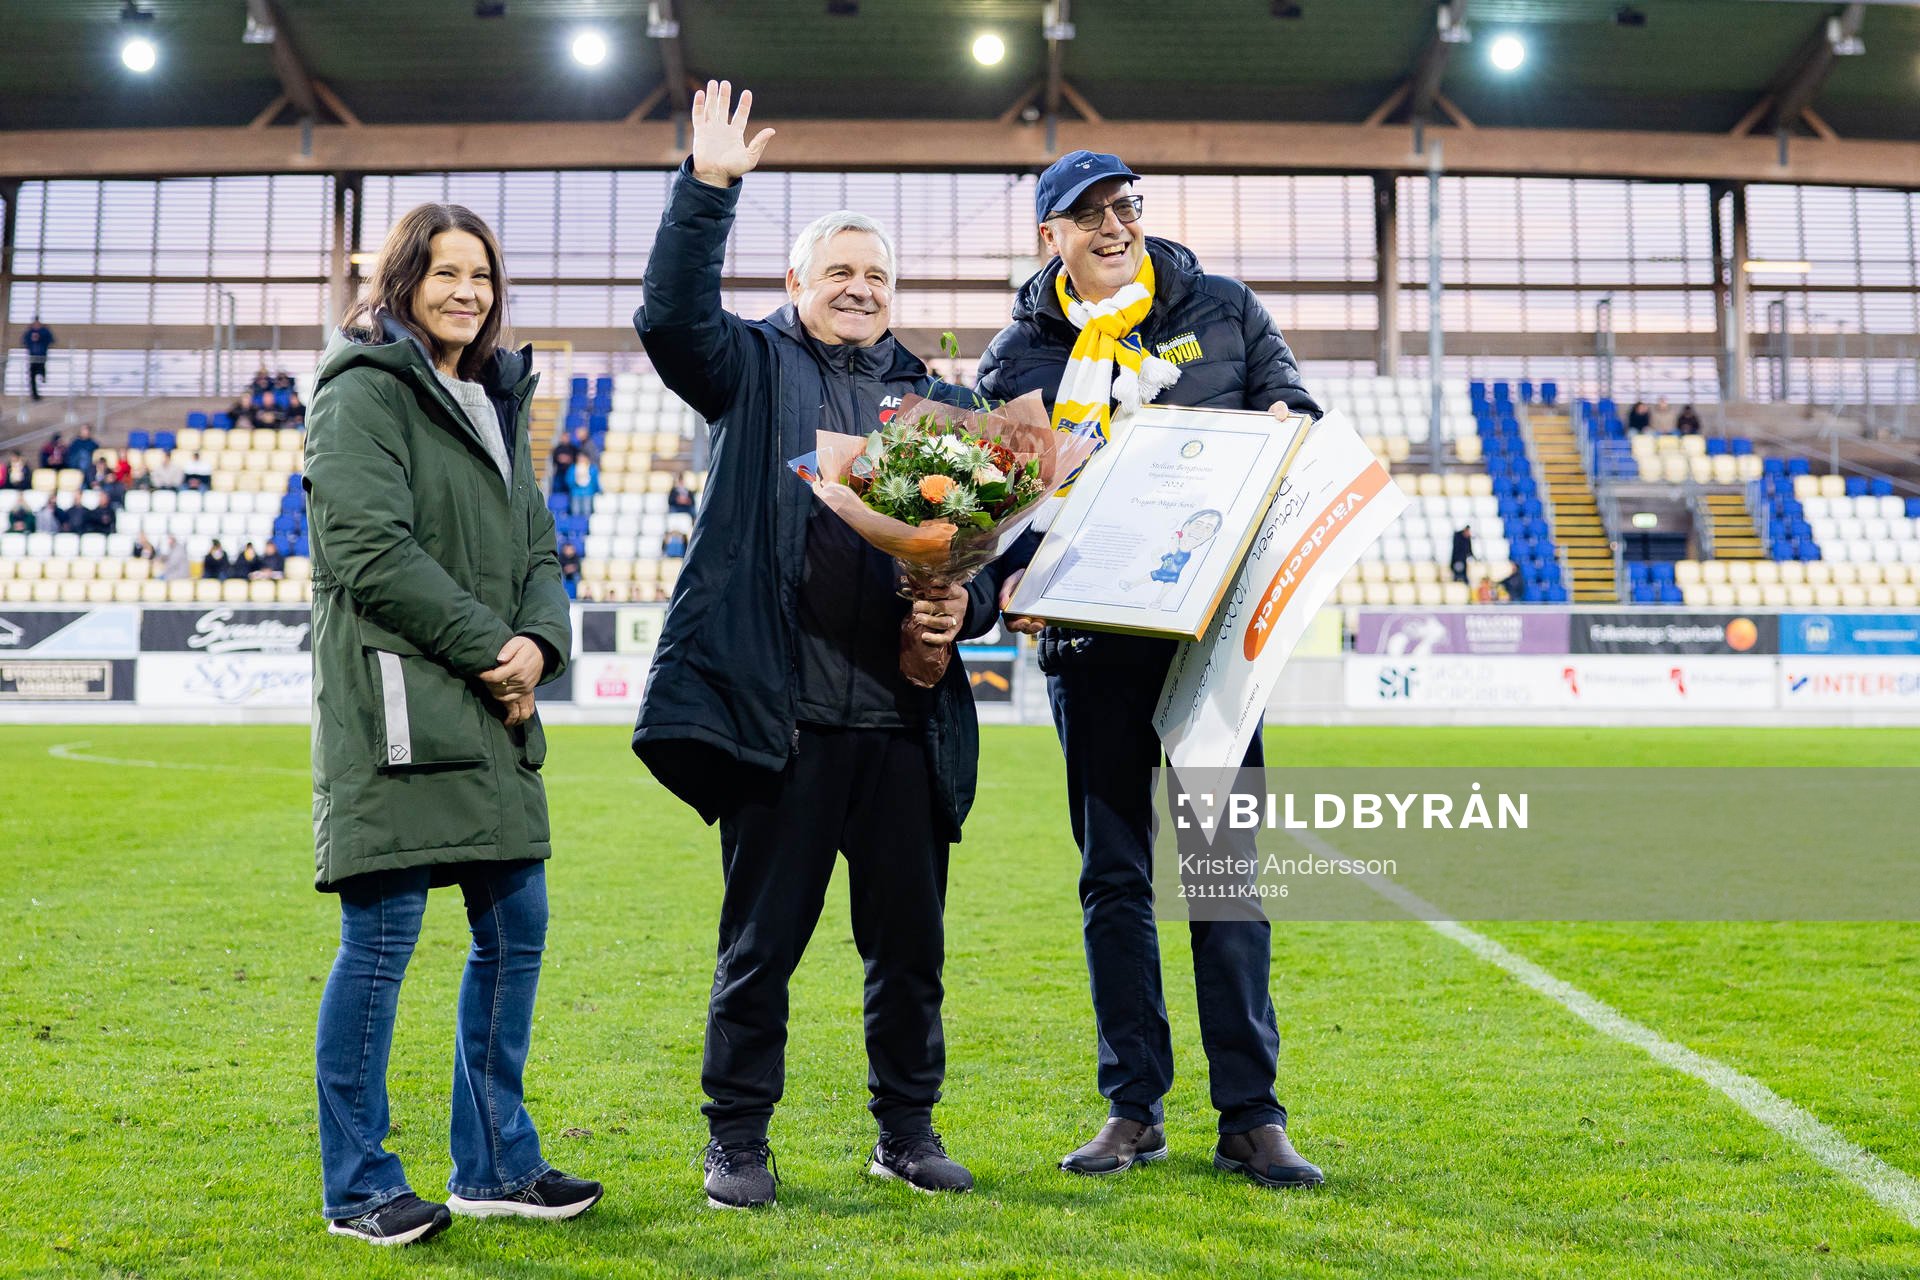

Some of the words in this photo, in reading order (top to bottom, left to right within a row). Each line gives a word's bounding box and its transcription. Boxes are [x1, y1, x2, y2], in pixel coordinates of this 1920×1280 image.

[1075, 158, 1093, 168] GANT
[1254, 492, 1364, 634] Värdecheck
[1813, 672, 1920, 696] INTERS
